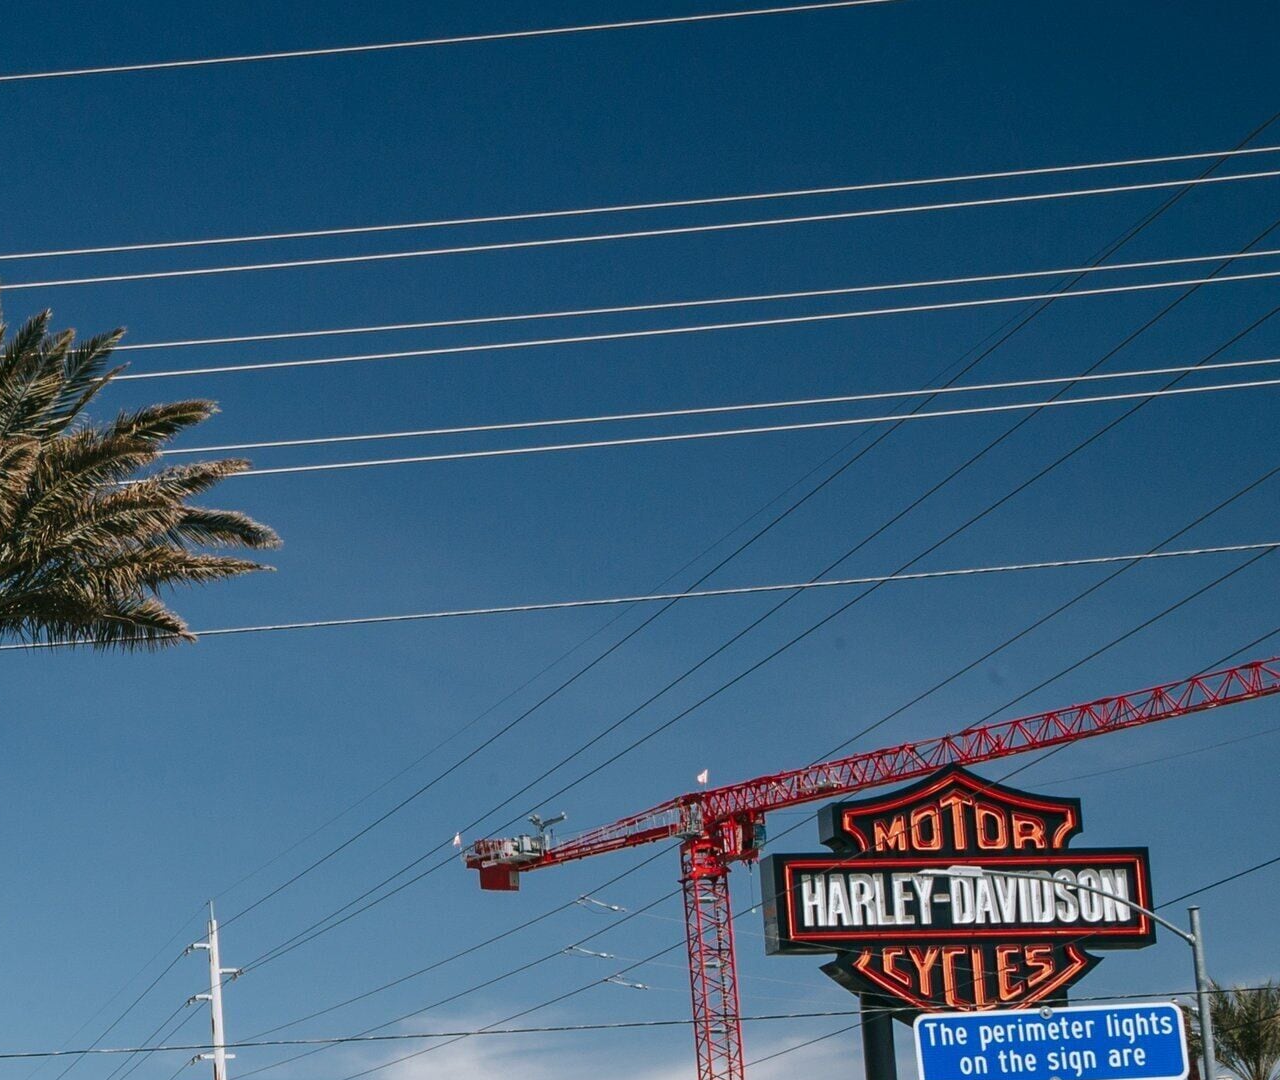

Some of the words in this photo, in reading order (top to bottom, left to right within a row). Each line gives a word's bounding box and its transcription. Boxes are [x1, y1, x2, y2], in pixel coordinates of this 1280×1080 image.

[873, 789, 1047, 852] MOTOR
[801, 867, 1132, 927] HARLEY-DAVIDSON
[882, 944, 1056, 1011] CYCLES
[924, 1021, 968, 1047] The
[979, 1016, 1096, 1051] perimeter
[1105, 1011, 1174, 1044] lights
[959, 1054, 988, 1076] on
[998, 1050, 1038, 1073] the
[1047, 1047, 1098, 1078] sign
[1108, 1046, 1147, 1068] are
